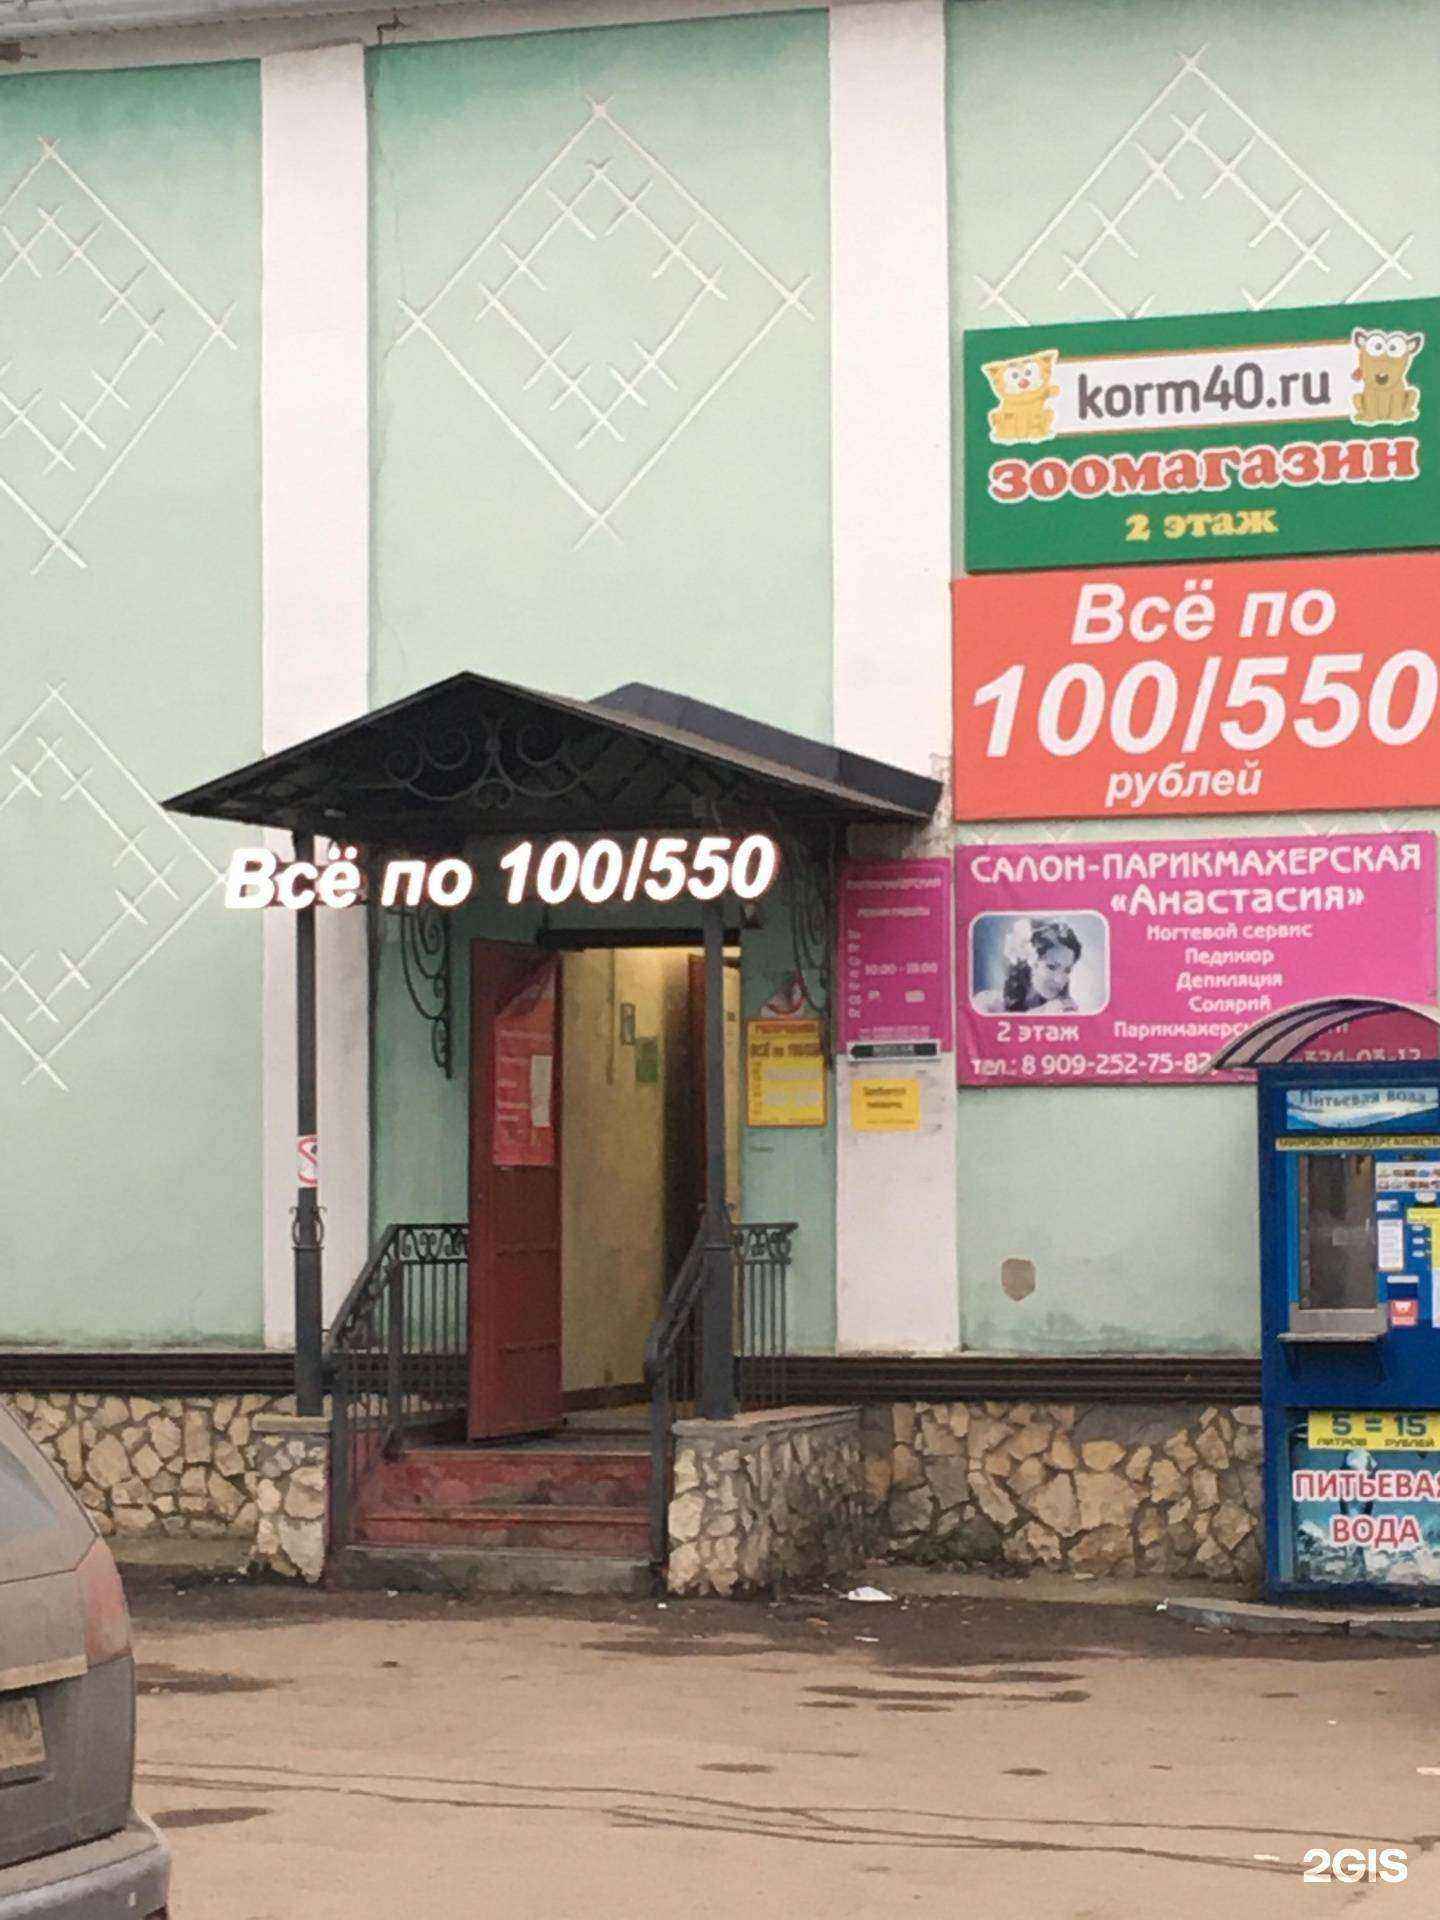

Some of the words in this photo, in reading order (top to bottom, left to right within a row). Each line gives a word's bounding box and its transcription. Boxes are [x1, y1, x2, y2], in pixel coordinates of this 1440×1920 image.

[1077, 361, 1331, 420] korm40.ru
[989, 437, 1419, 503] зоомагазин
[1125, 513, 1150, 541] 2
[1163, 507, 1278, 539] этаж
[1071, 578, 1216, 645] Всё
[1239, 587, 1337, 638] по
[973, 649, 1440, 758] 100/550
[1104, 759, 1263, 808] рублей
[223, 845, 362, 909] Всё
[380, 858, 473, 907] по
[500, 834, 777, 905] 100/550
[970, 843, 1421, 883] САЛОН-ПАРИКМАХЕРСКАЯ
[1110, 883, 1365, 916] «Анастасия»
[1146, 923, 1238, 941] Ногтевой
[1242, 923, 1313, 942] сервис
[1184, 946, 1275, 966] Педикюр
[1176, 971, 1283, 991] Депиляция
[1188, 994, 1272, 1014] Солярий
[996, 1021, 1011, 1042] 2
[1018, 1024, 1080, 1042] этаж
[1113, 1020, 1248, 1040] Парикмахерс
[1021, 1053, 1037, 1075] 8
[1331, 1411, 1352, 1436] 5
[1394, 1411, 1427, 1437] 15
[1293, 1470, 1440, 1500] ПИТЬЕВА
[1330, 1515, 1421, 1549] ВОДА
